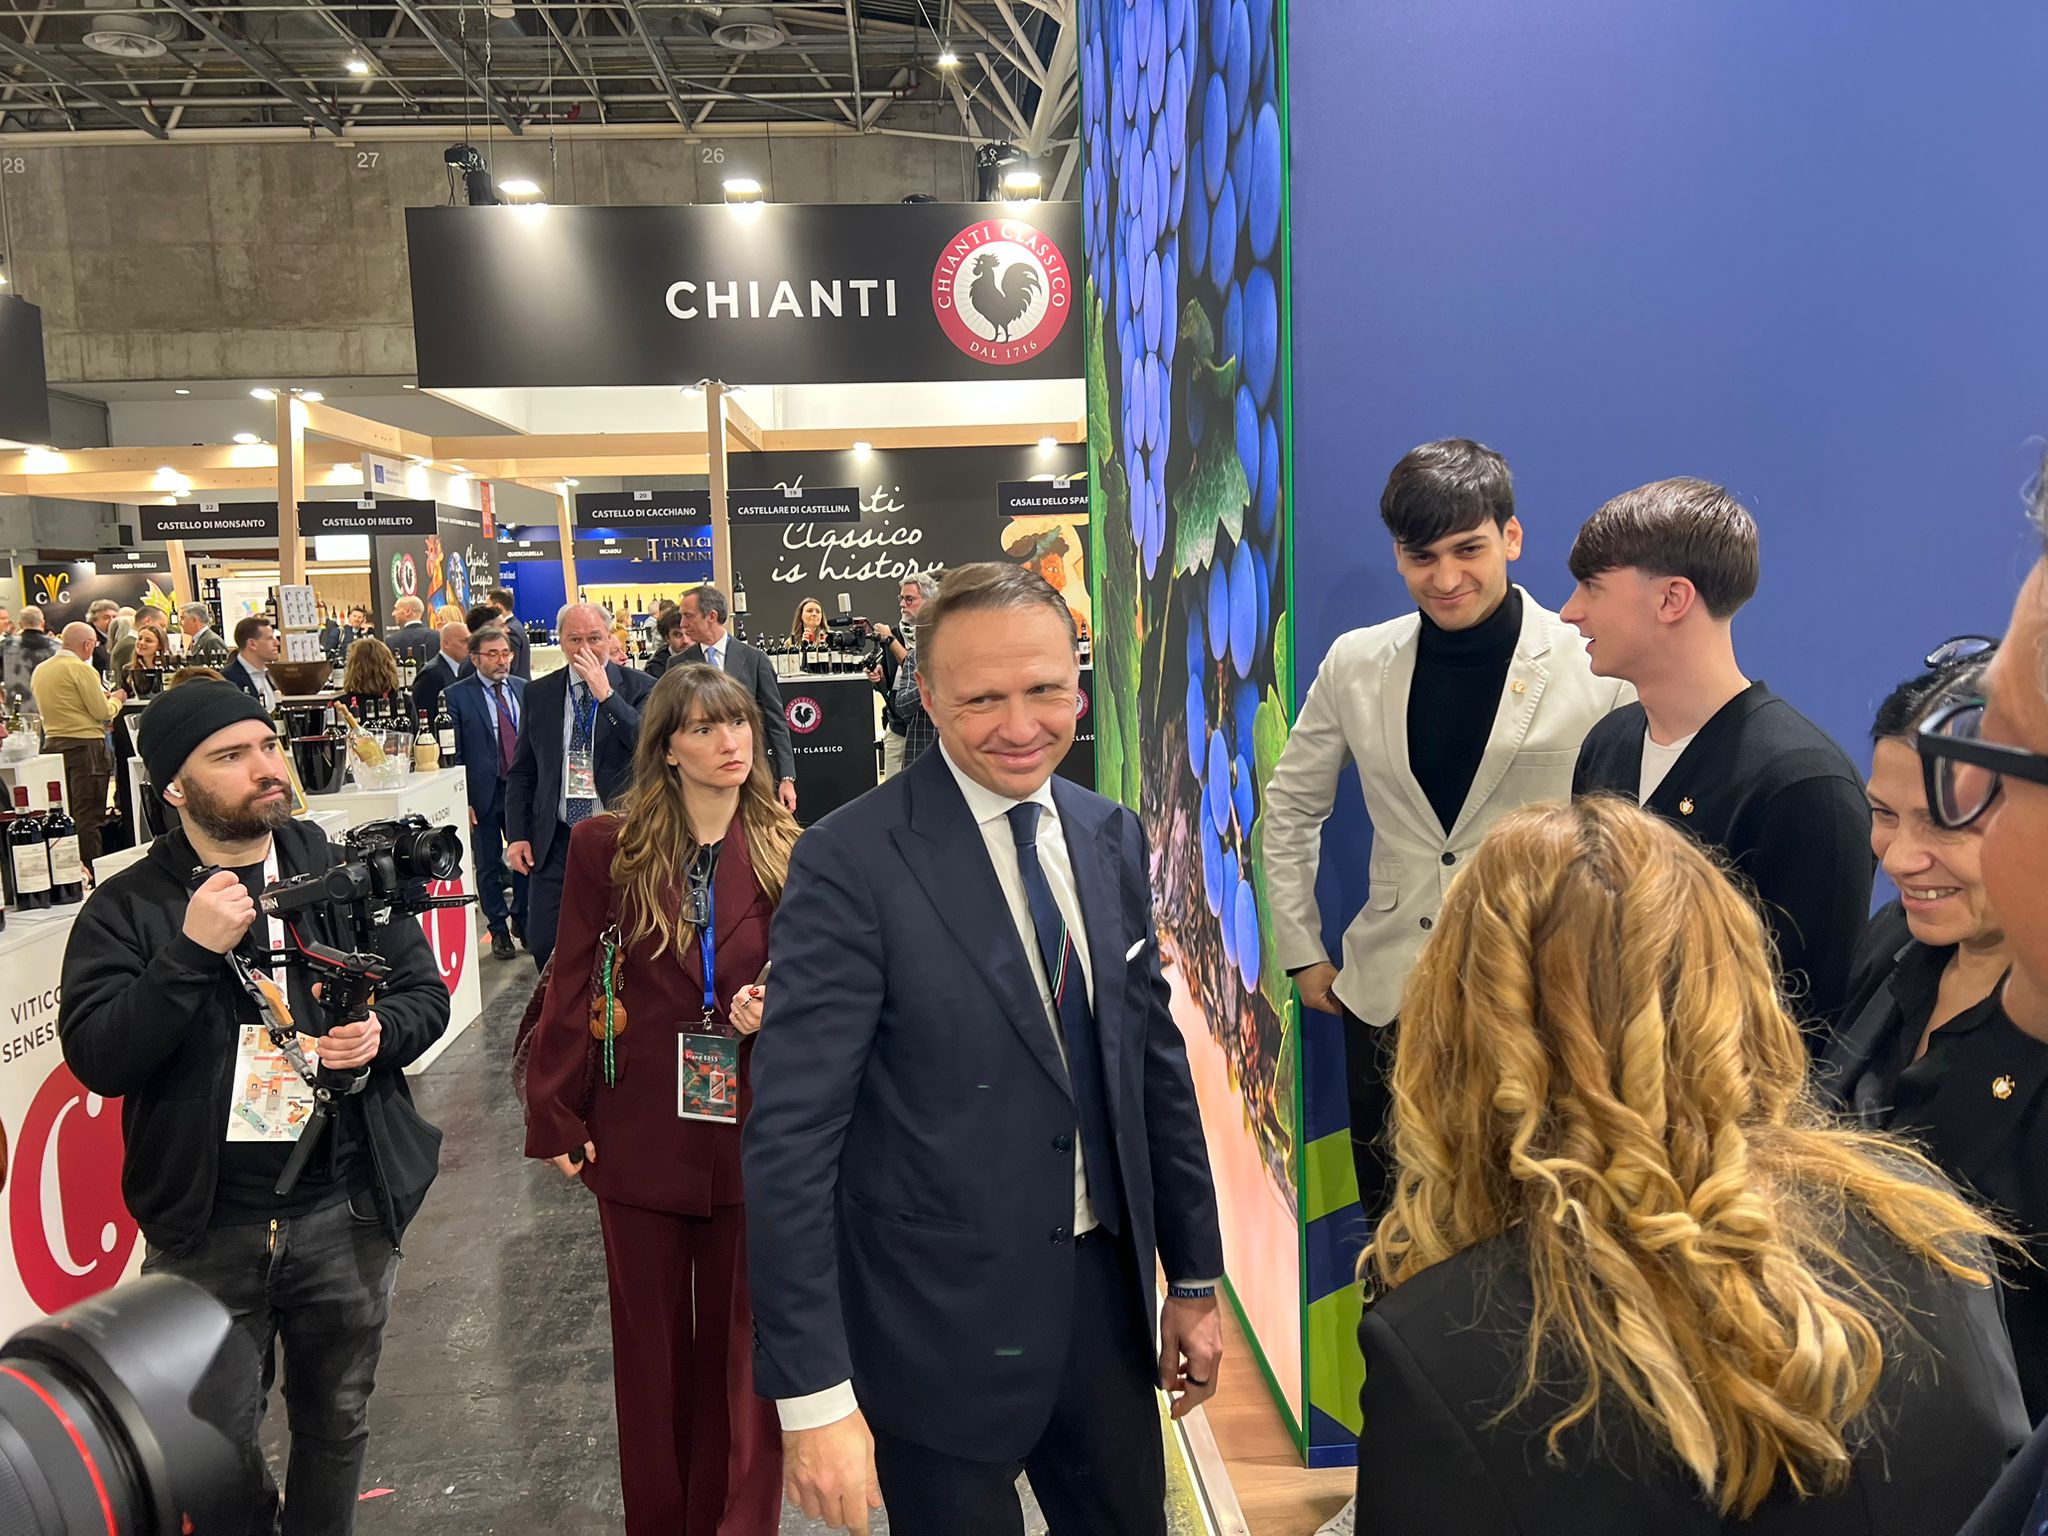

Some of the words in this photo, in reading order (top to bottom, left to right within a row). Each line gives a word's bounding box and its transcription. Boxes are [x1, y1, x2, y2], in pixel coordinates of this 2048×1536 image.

[357, 152, 379, 168] 27
[702, 147, 725, 164] 26
[2, 157, 26, 174] 28
[938, 226, 991, 309] CHIANTI
[1001, 224, 1066, 308] CLASSICO
[665, 279, 897, 320] CHIANTI
[969, 341, 998, 359] DAL
[1006, 340, 1038, 359] 1716
[737, 506, 789, 515] CASTELLARE
[790, 506, 800, 514] DI
[800, 504, 851, 514] CASTELLINA
[1010, 498, 1041, 507] CASALE
[1042, 496, 1069, 506] DELLO
[592, 509, 635, 518] CASTELLO
[636, 508, 645, 517] DI
[646, 507, 697, 517] CACCHIANO
[157, 521, 202, 531] CASTELLO
[203, 520, 213, 530] DI
[214, 519, 266, 529] MONSANTO
[322, 518, 366, 526] CASTELLO
[367, 517, 377, 526] DI
[378, 517, 413, 526] MELETO
[783, 520, 923, 550] Classico
[771, 555, 808, 583] is
[803, 745, 843, 754] CLASSICO
